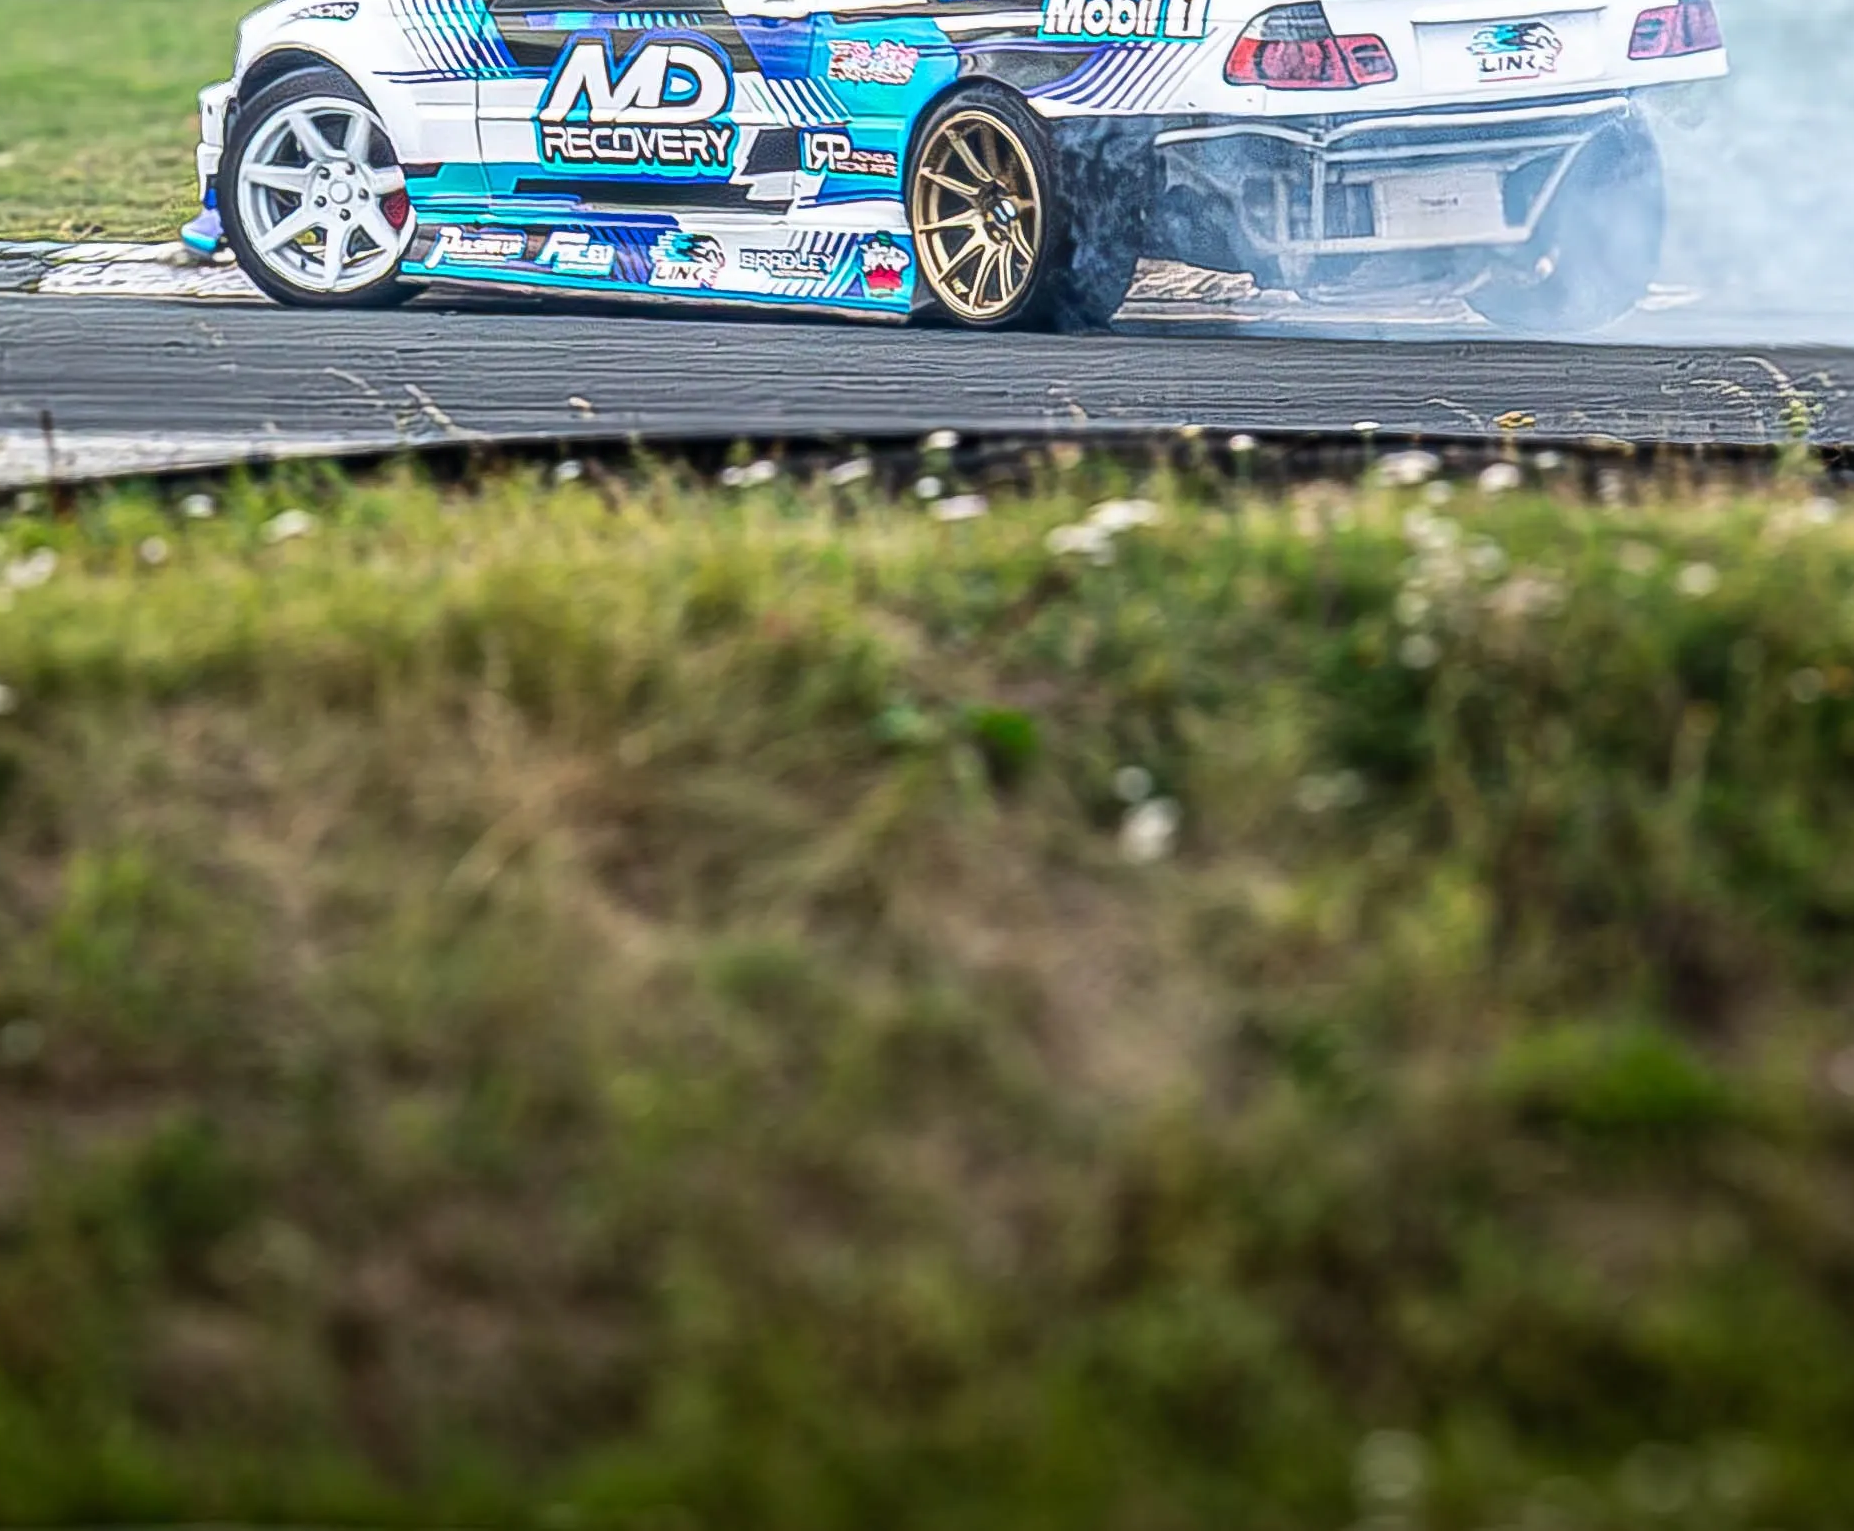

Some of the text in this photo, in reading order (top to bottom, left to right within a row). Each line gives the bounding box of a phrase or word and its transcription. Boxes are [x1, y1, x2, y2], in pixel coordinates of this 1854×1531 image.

[539, 43, 729, 124] MD
[542, 125, 732, 163] RECOVERY
[740, 249, 835, 273] BRADLEY
